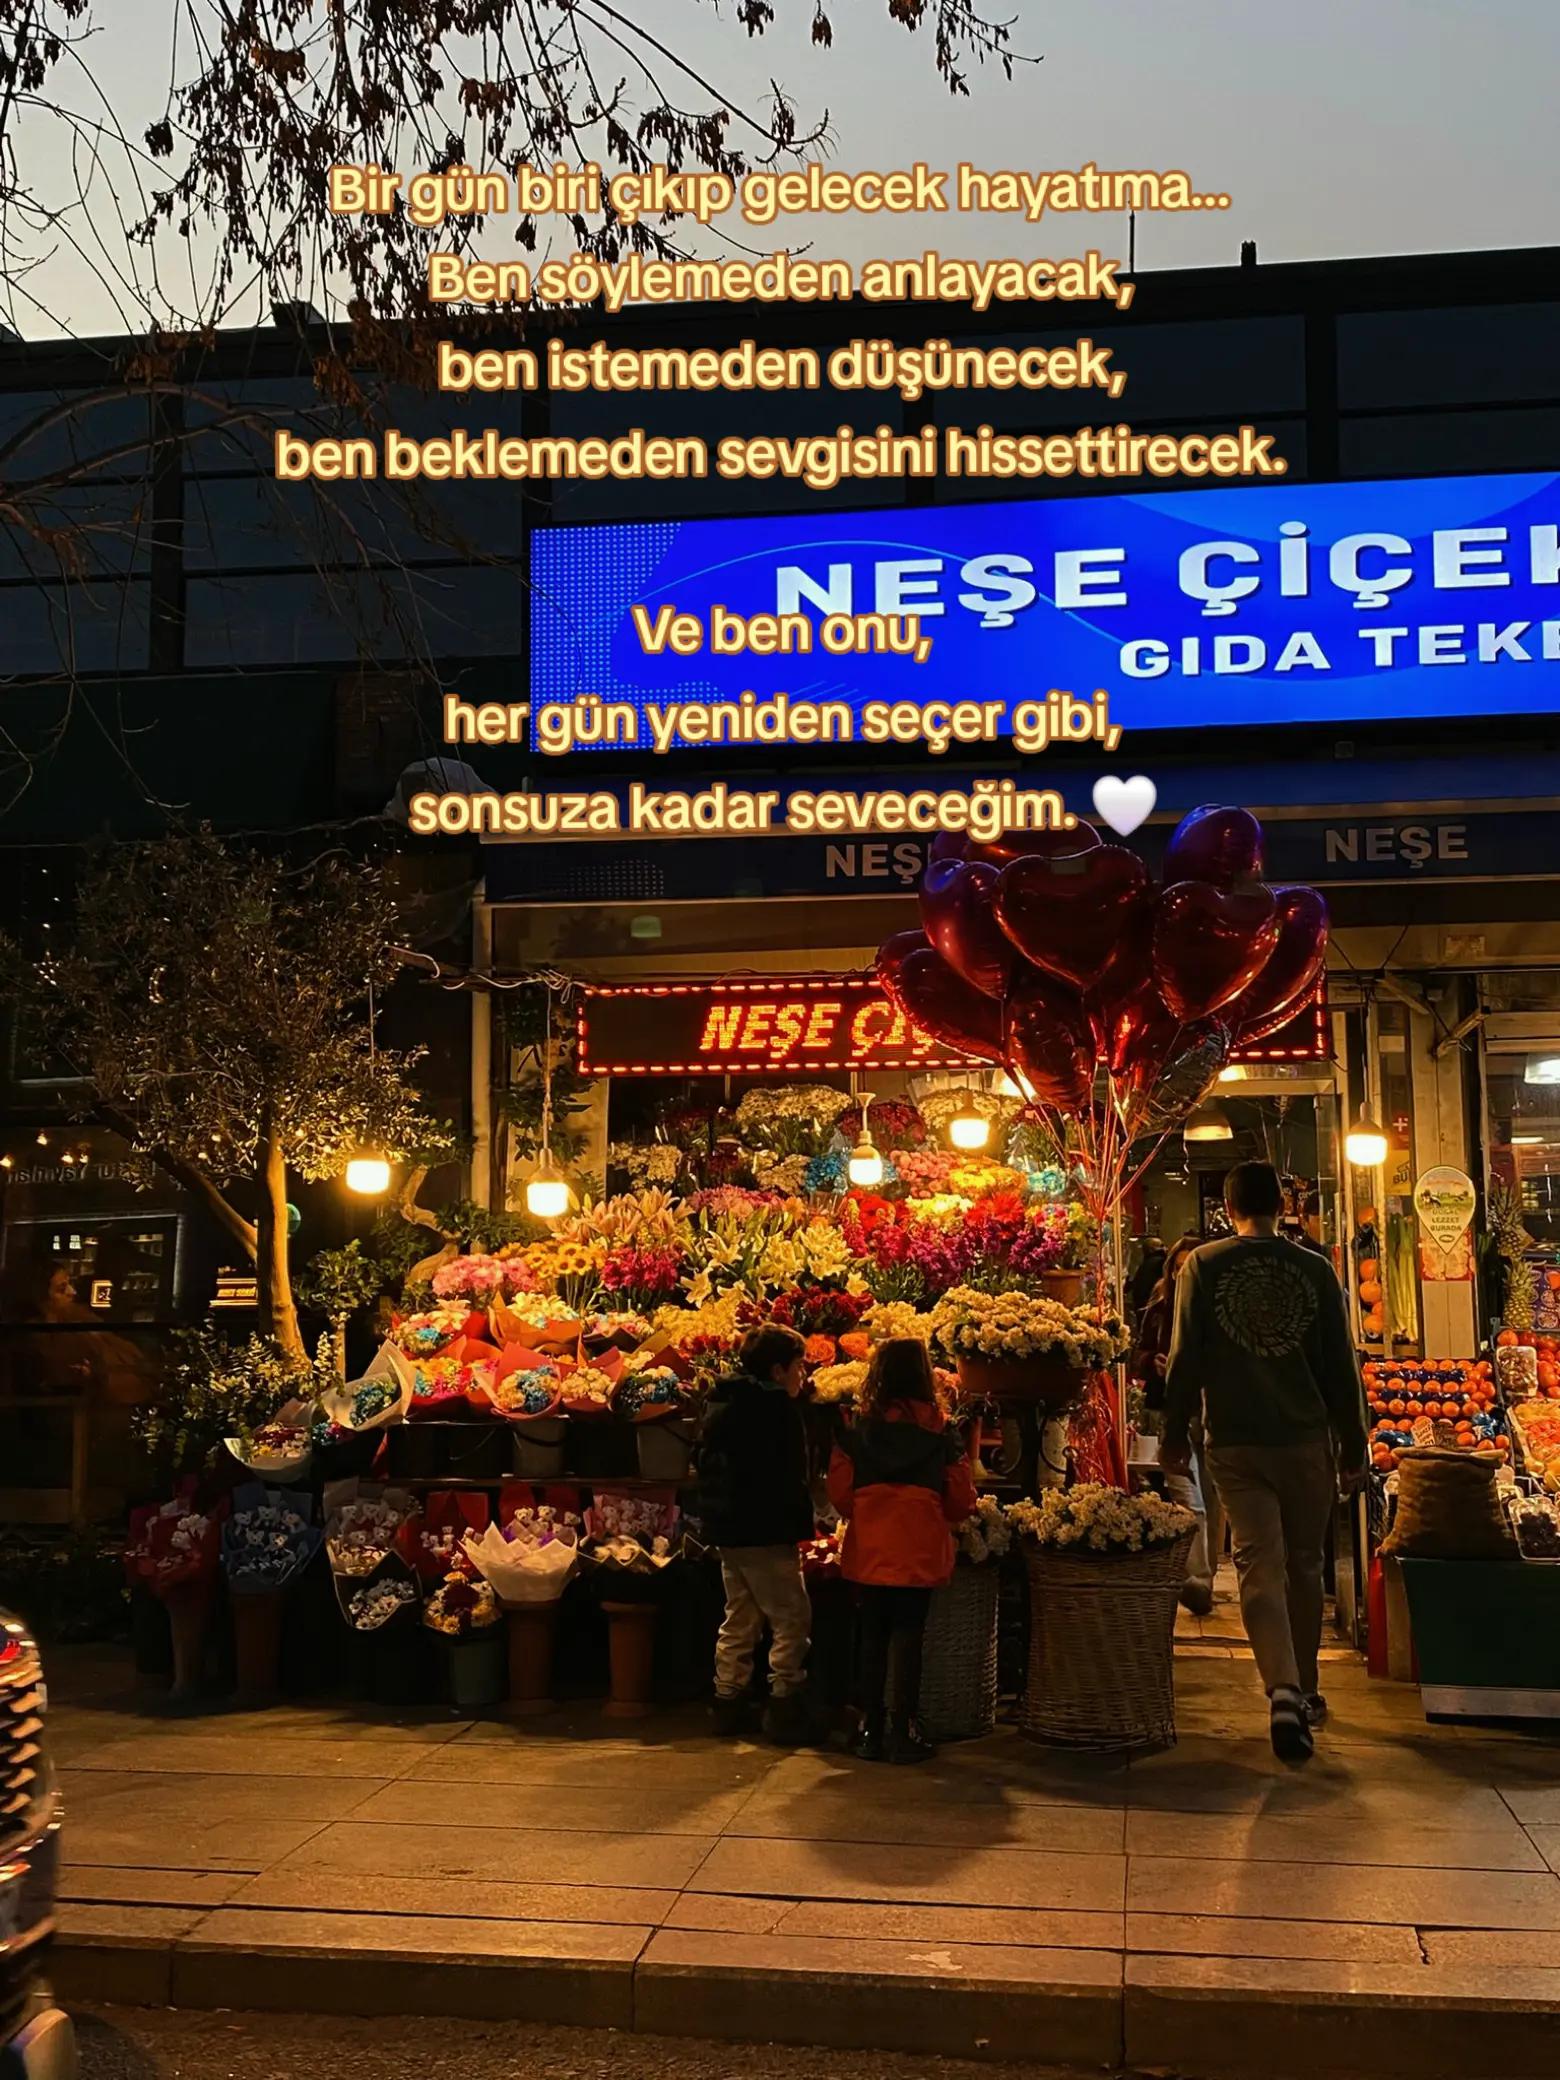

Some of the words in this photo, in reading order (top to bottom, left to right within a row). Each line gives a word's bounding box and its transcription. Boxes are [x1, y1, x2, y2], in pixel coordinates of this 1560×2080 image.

[776, 547, 1128, 628] NEŞE
[1119, 630, 1332, 679] GIDA
[825, 842, 933, 885] NEŞ
[1325, 824, 1471, 869] NEŞE
[699, 1002, 842, 1059] NEŞE
